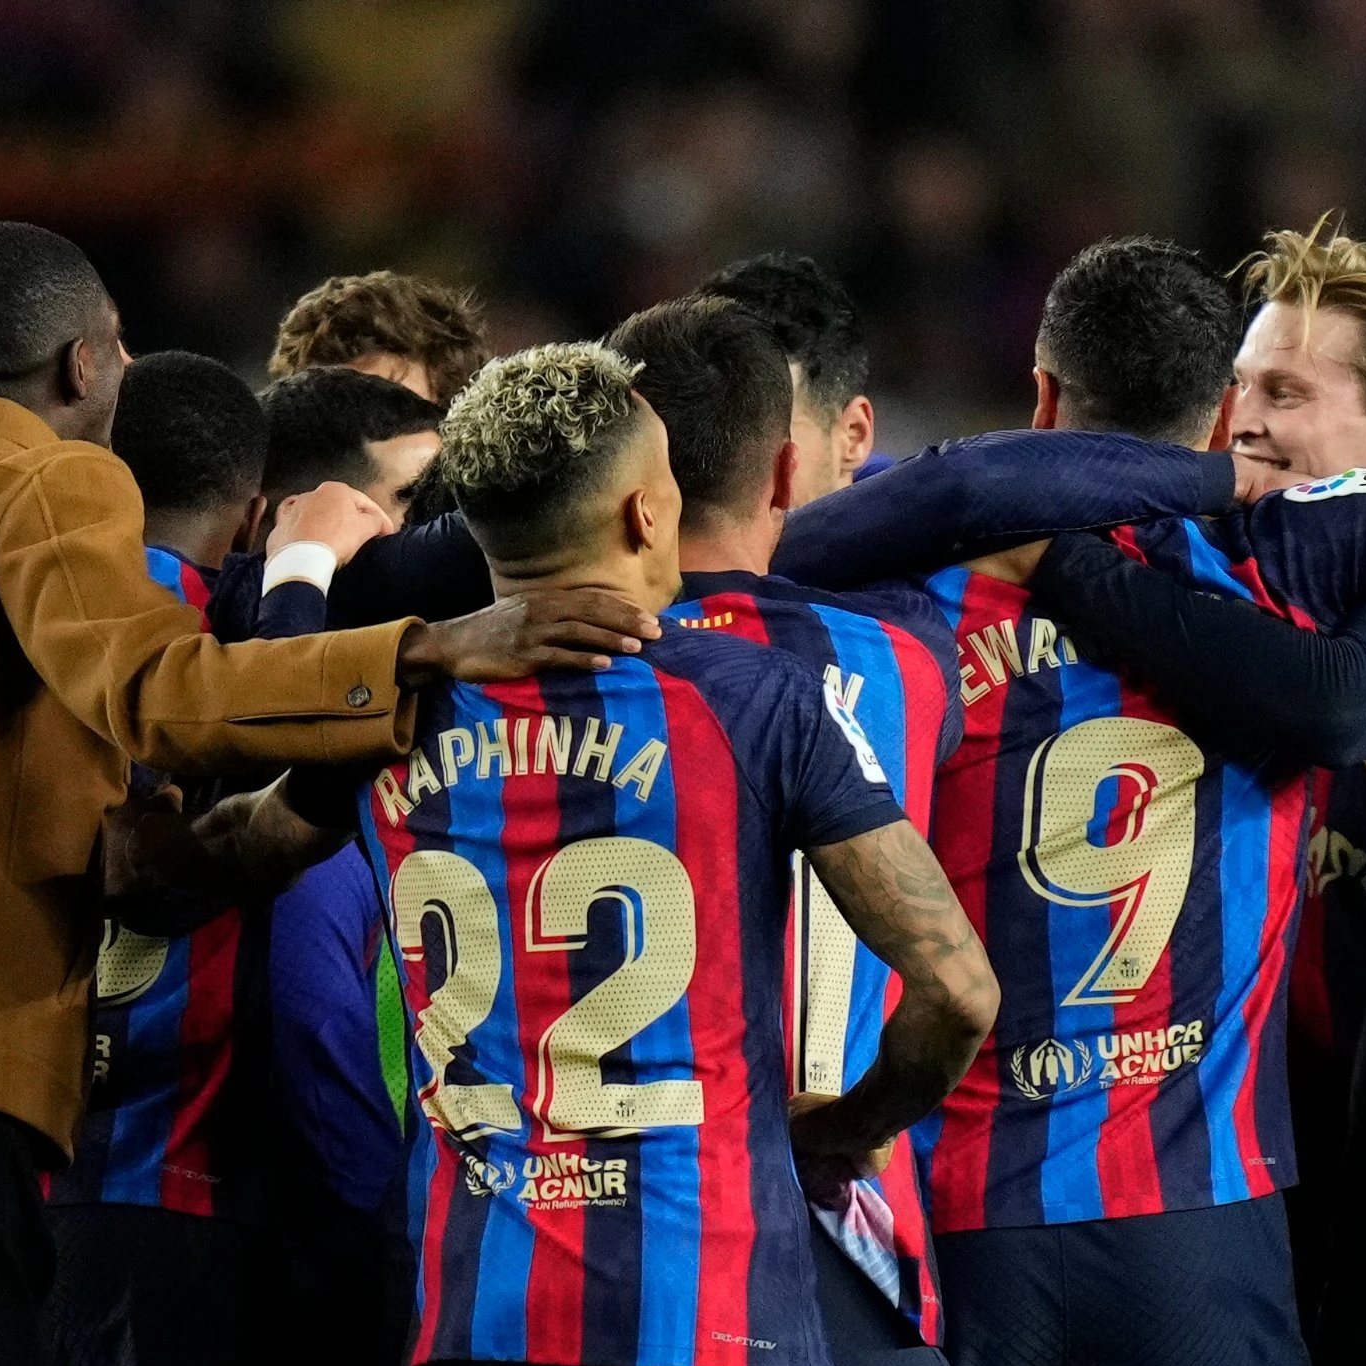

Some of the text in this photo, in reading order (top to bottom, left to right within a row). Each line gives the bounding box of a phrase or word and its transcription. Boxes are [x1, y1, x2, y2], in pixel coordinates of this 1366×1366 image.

[373, 715, 668, 828] RAPHINHA
[1017, 716, 1206, 1007] 9
[390, 836, 706, 1143] 22
[1097, 1019, 1204, 1061] UNHCR
[1098, 1043, 1203, 1080] ACNUR
[522, 1152, 628, 1180] UNHCR
[516, 1172, 627, 1202] ACNUR
[536, 1200, 551, 1211] UN
[553, 1199, 591, 1211] Refugee
[592, 1197, 627, 1208] Agency
